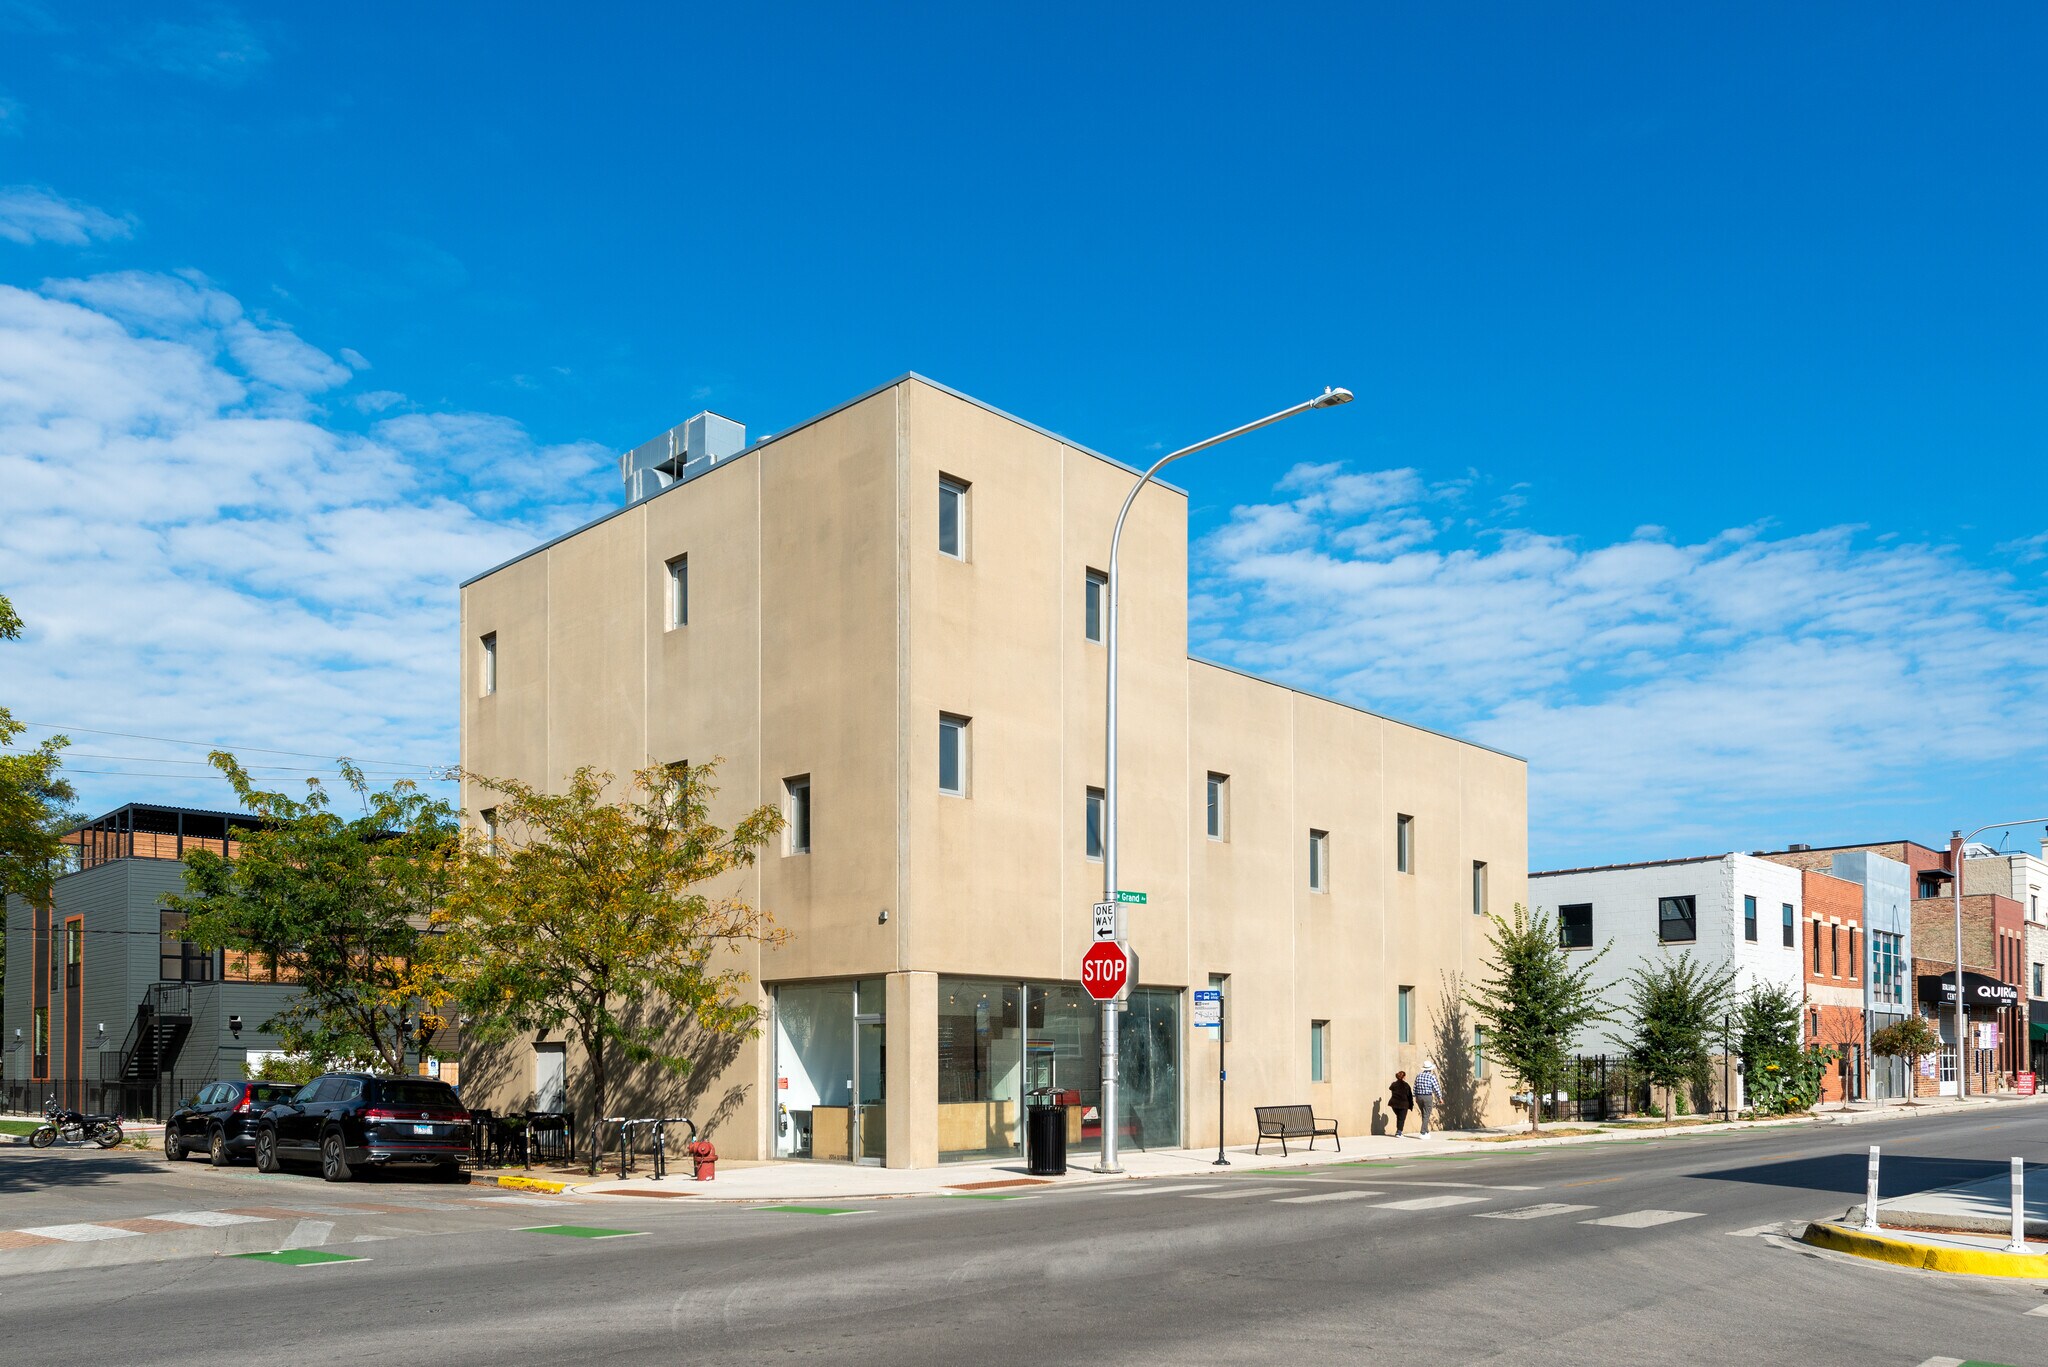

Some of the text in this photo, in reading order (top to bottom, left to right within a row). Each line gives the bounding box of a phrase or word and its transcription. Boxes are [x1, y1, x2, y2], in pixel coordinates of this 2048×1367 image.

[1121, 892, 1140, 902] Grand
[1095, 905, 1113, 915] ONE
[1095, 916, 1114, 926] WAY
[1084, 959, 1125, 982] STOP
